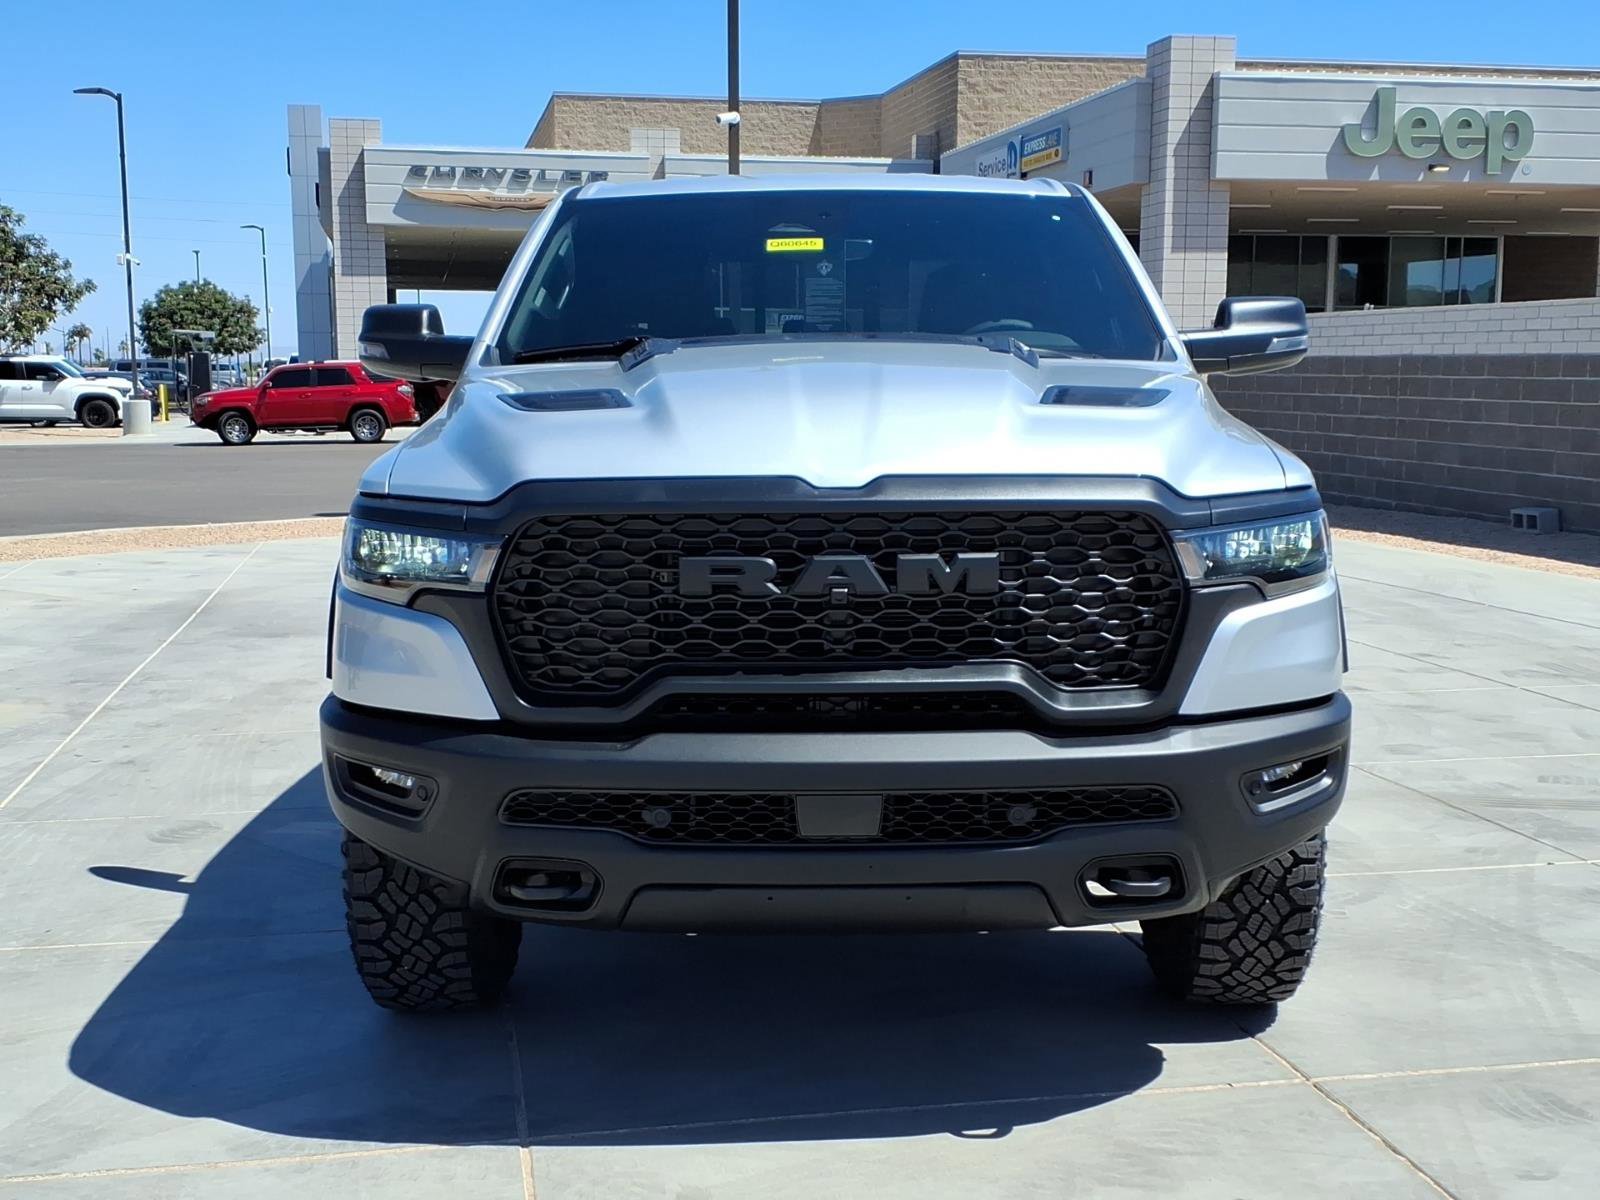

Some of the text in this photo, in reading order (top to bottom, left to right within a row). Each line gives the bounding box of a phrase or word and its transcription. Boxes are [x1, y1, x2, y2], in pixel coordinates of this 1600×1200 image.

[1343, 86, 1535, 175] Jeep
[408, 164, 610, 184] CHRYSLER
[978, 156, 1007, 177] Service
[679, 552, 1000, 594] RAM
